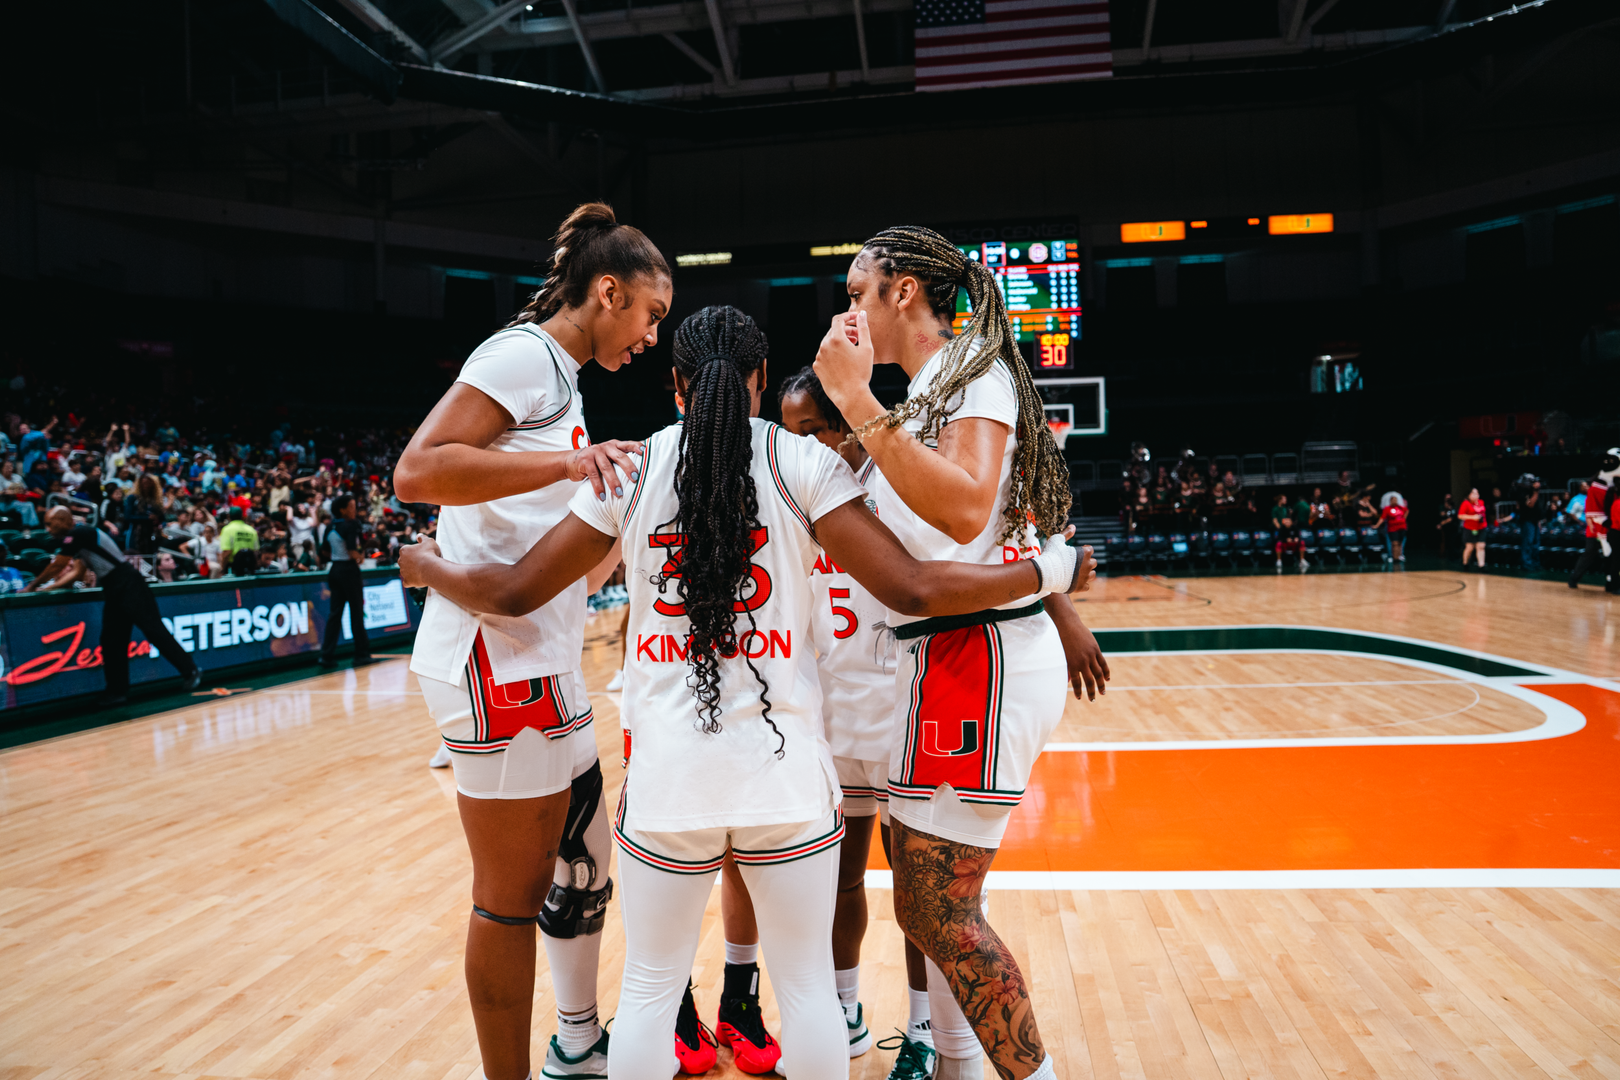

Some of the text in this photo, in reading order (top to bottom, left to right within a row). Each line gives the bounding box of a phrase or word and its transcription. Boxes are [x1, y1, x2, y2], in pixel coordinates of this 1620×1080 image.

[1040, 345, 1067, 367] 30
[828, 586, 859, 640] 5
[6, 620, 151, 686] Jesca
[922, 719, 979, 757] U
